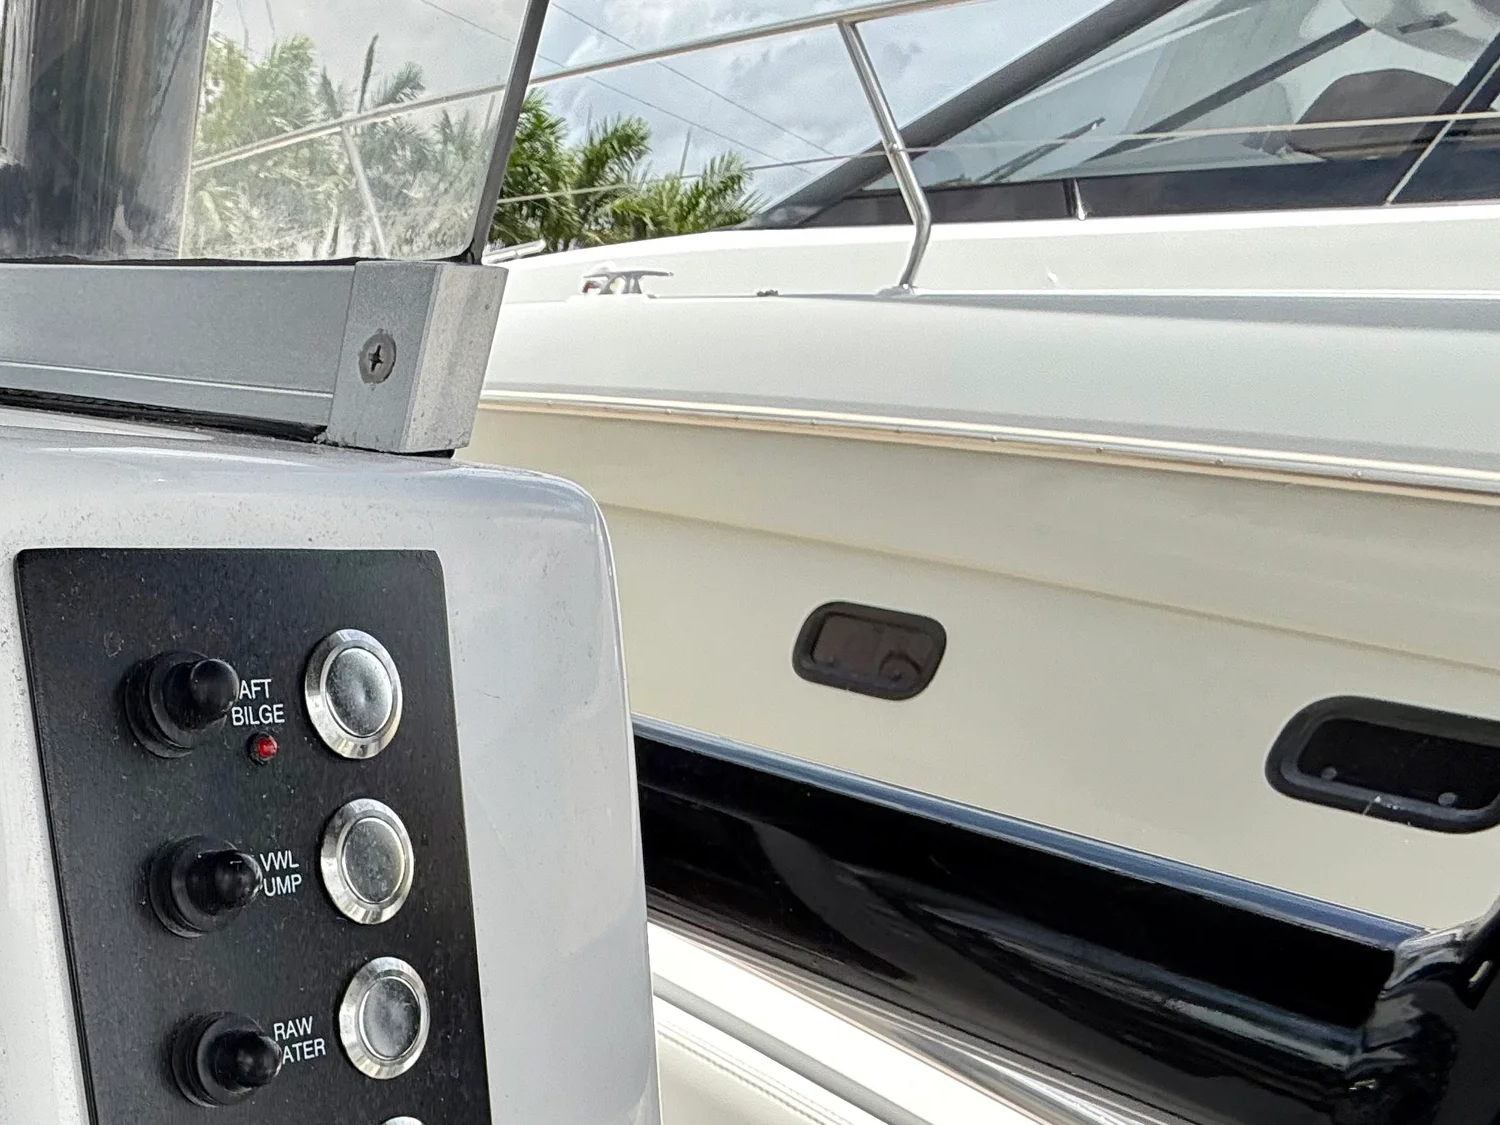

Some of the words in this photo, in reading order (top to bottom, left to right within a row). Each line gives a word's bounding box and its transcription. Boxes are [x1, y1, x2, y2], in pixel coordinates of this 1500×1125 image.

[239, 679, 272, 699] AFT
[231, 704, 285, 726] BILGE
[260, 850, 299, 872] VWL
[263, 874, 302, 896] UMP
[273, 1016, 313, 1042] RAW
[282, 1039, 326, 1064] ATER
